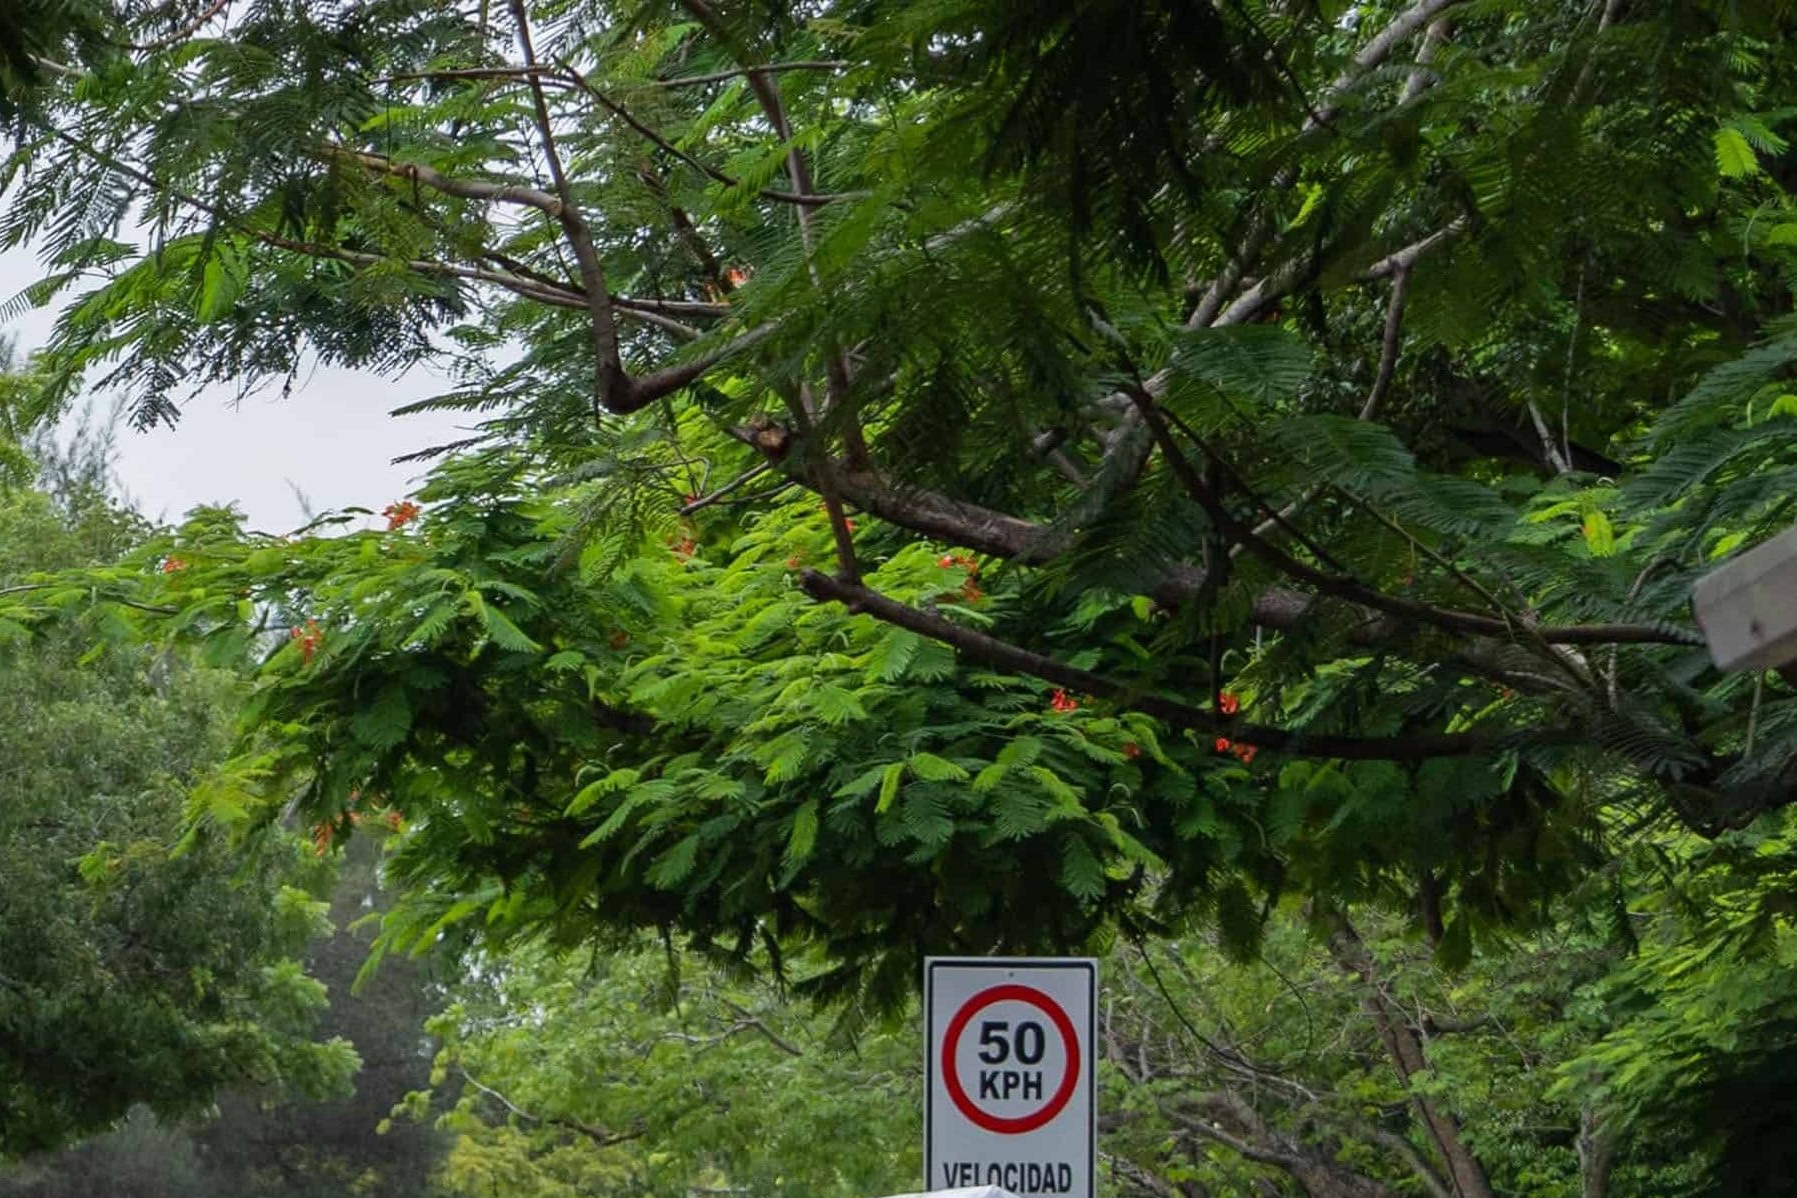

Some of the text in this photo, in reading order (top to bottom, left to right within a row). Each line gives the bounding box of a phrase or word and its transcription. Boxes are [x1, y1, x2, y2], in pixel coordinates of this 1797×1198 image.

[978, 1021, 1045, 1065] 50
[979, 1070, 1043, 1101] KPH
[943, 1162, 1072, 1194] VELOCIDAD
